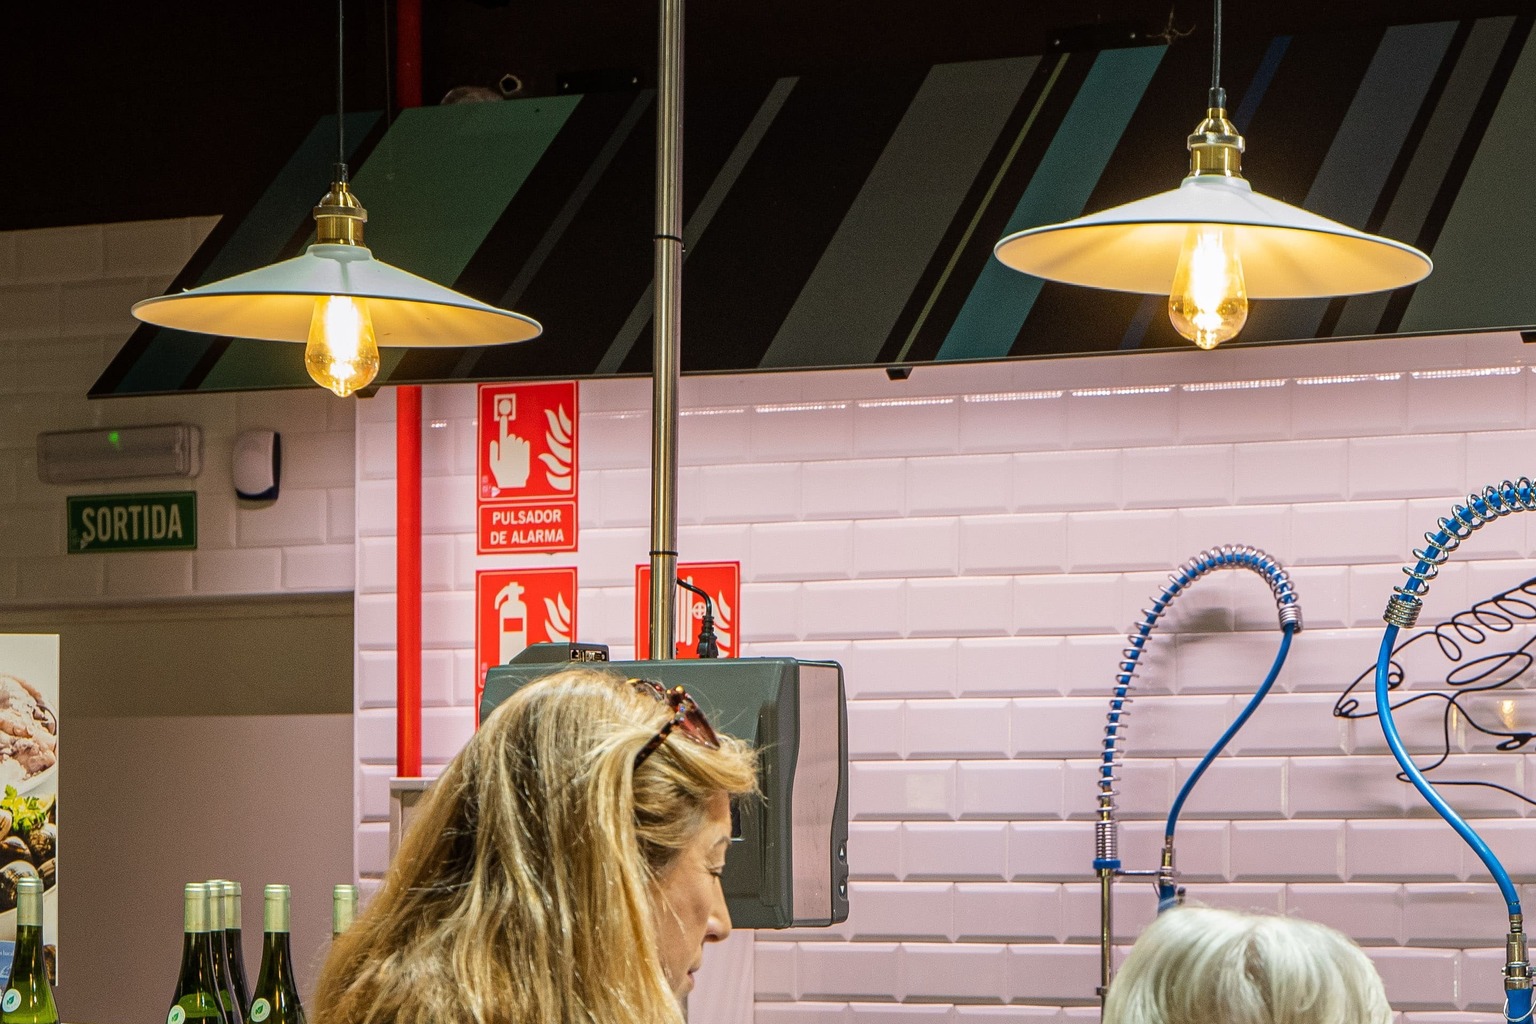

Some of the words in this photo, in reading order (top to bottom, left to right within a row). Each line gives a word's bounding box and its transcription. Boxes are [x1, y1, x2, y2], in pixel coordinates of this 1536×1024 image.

[82, 503, 183, 542] SORTIDA
[492, 509, 562, 526] PULSADOR
[490, 531, 507, 545] DE
[511, 529, 565, 544] ALARMA
